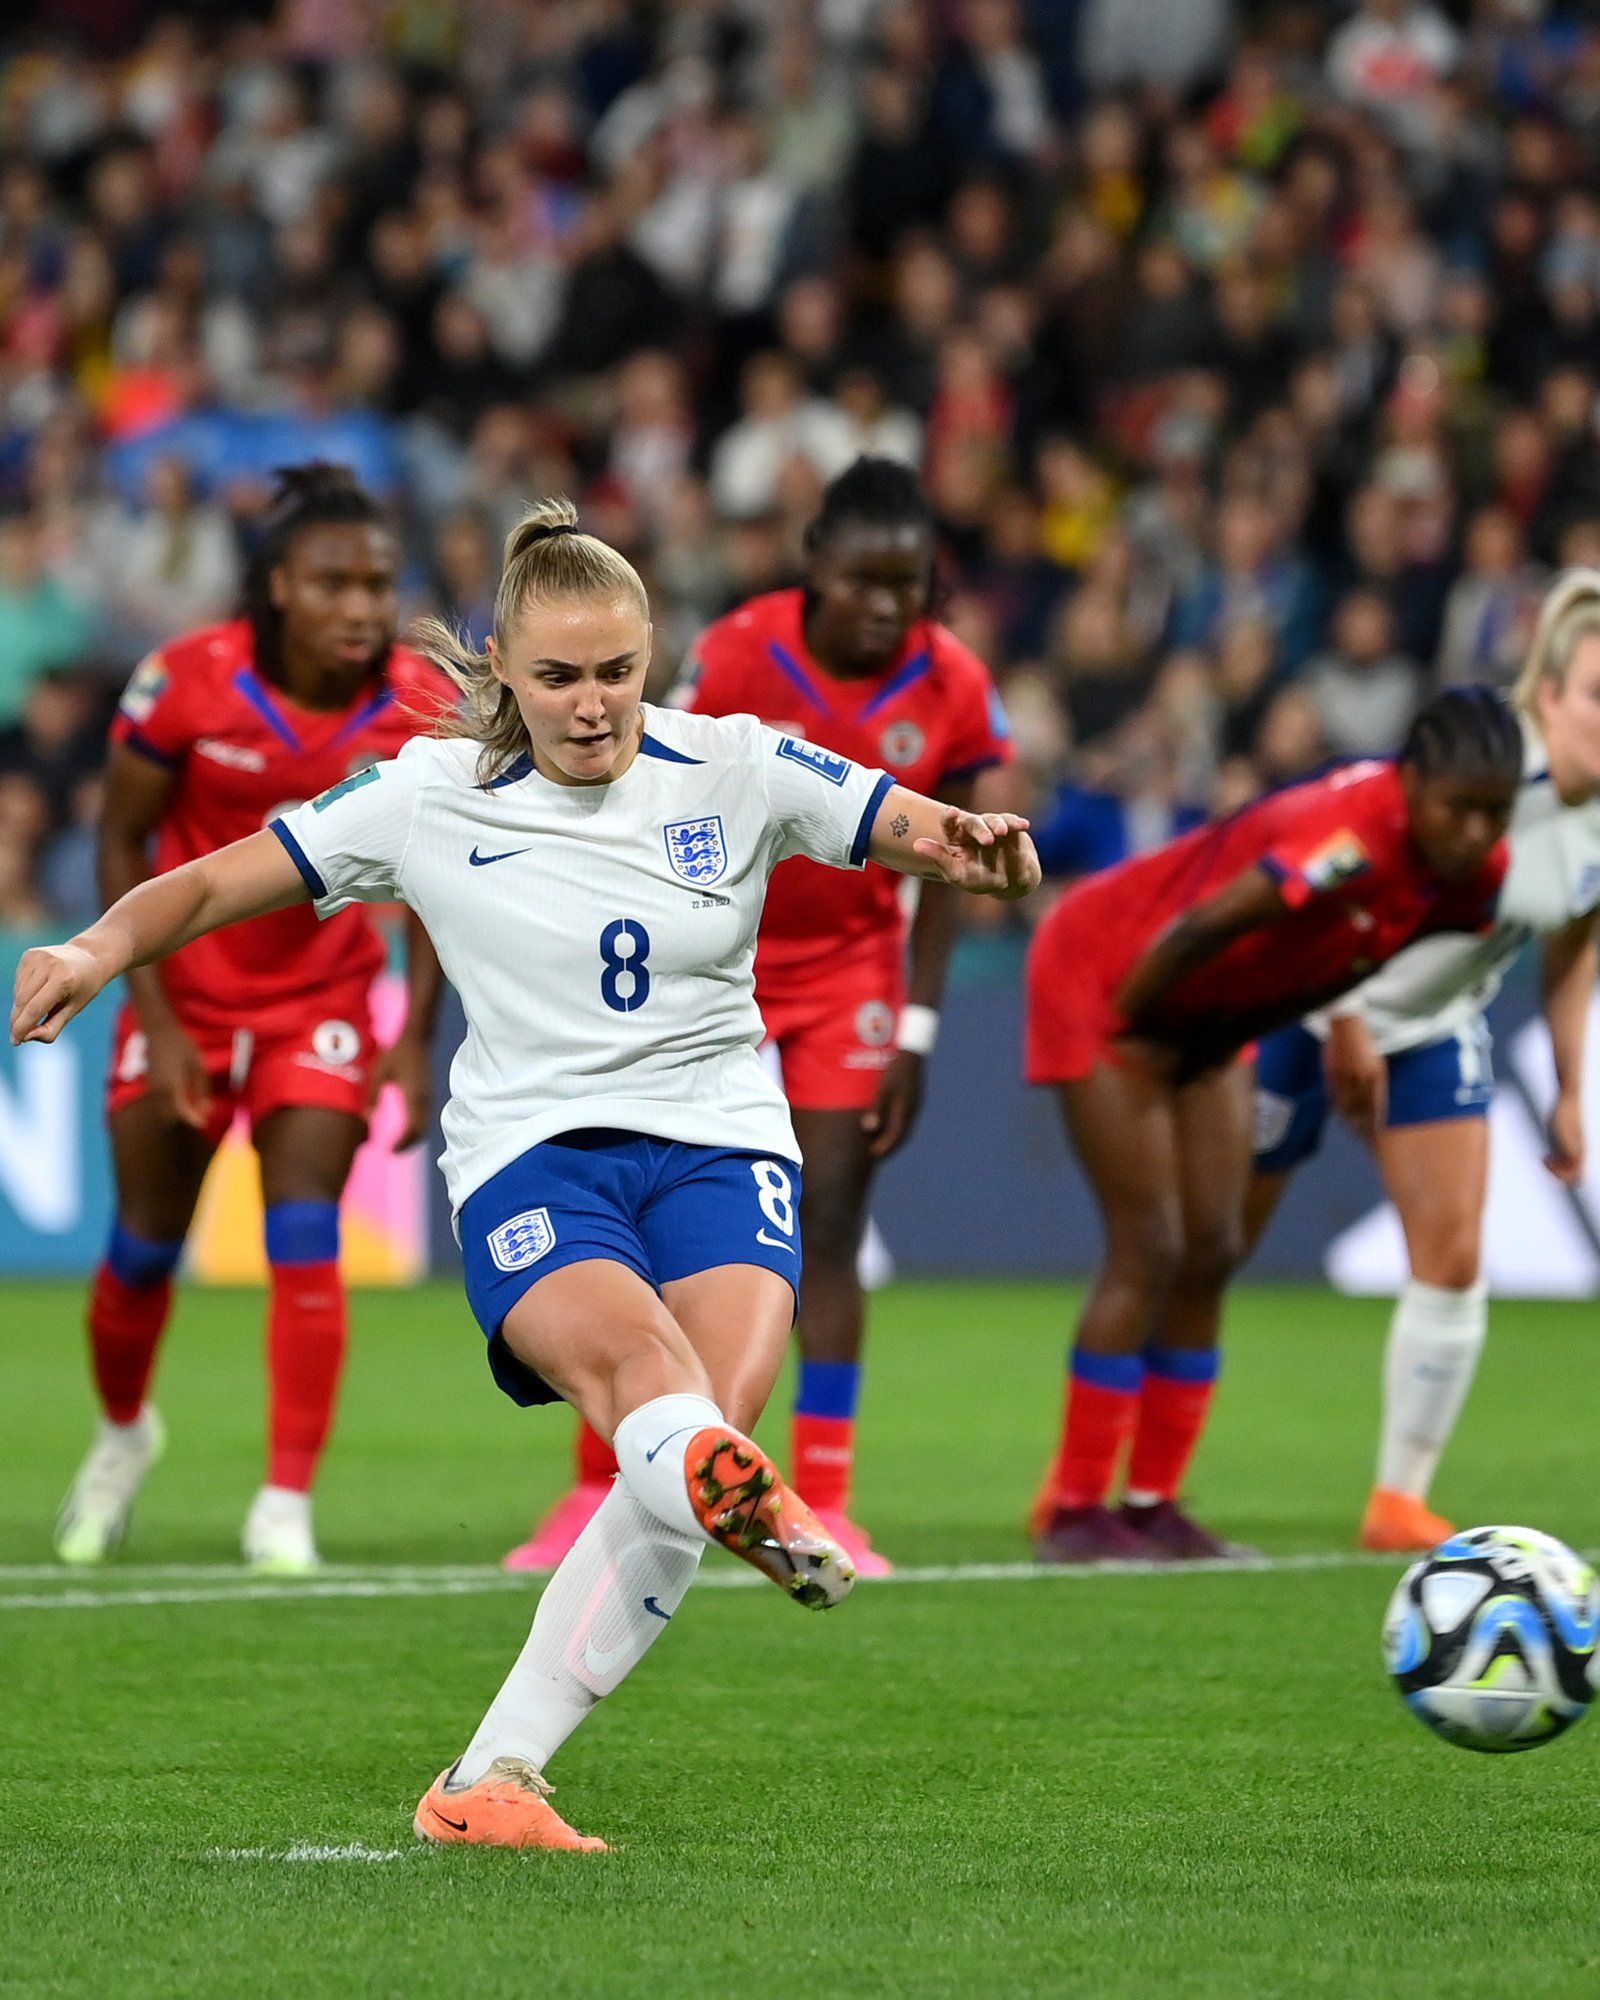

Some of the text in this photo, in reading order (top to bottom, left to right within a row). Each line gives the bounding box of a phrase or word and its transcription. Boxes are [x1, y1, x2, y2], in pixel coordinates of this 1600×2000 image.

[691, 900, 700, 909] 22
[600, 918, 650, 1012] 8
[750, 1160, 794, 1237] 8
